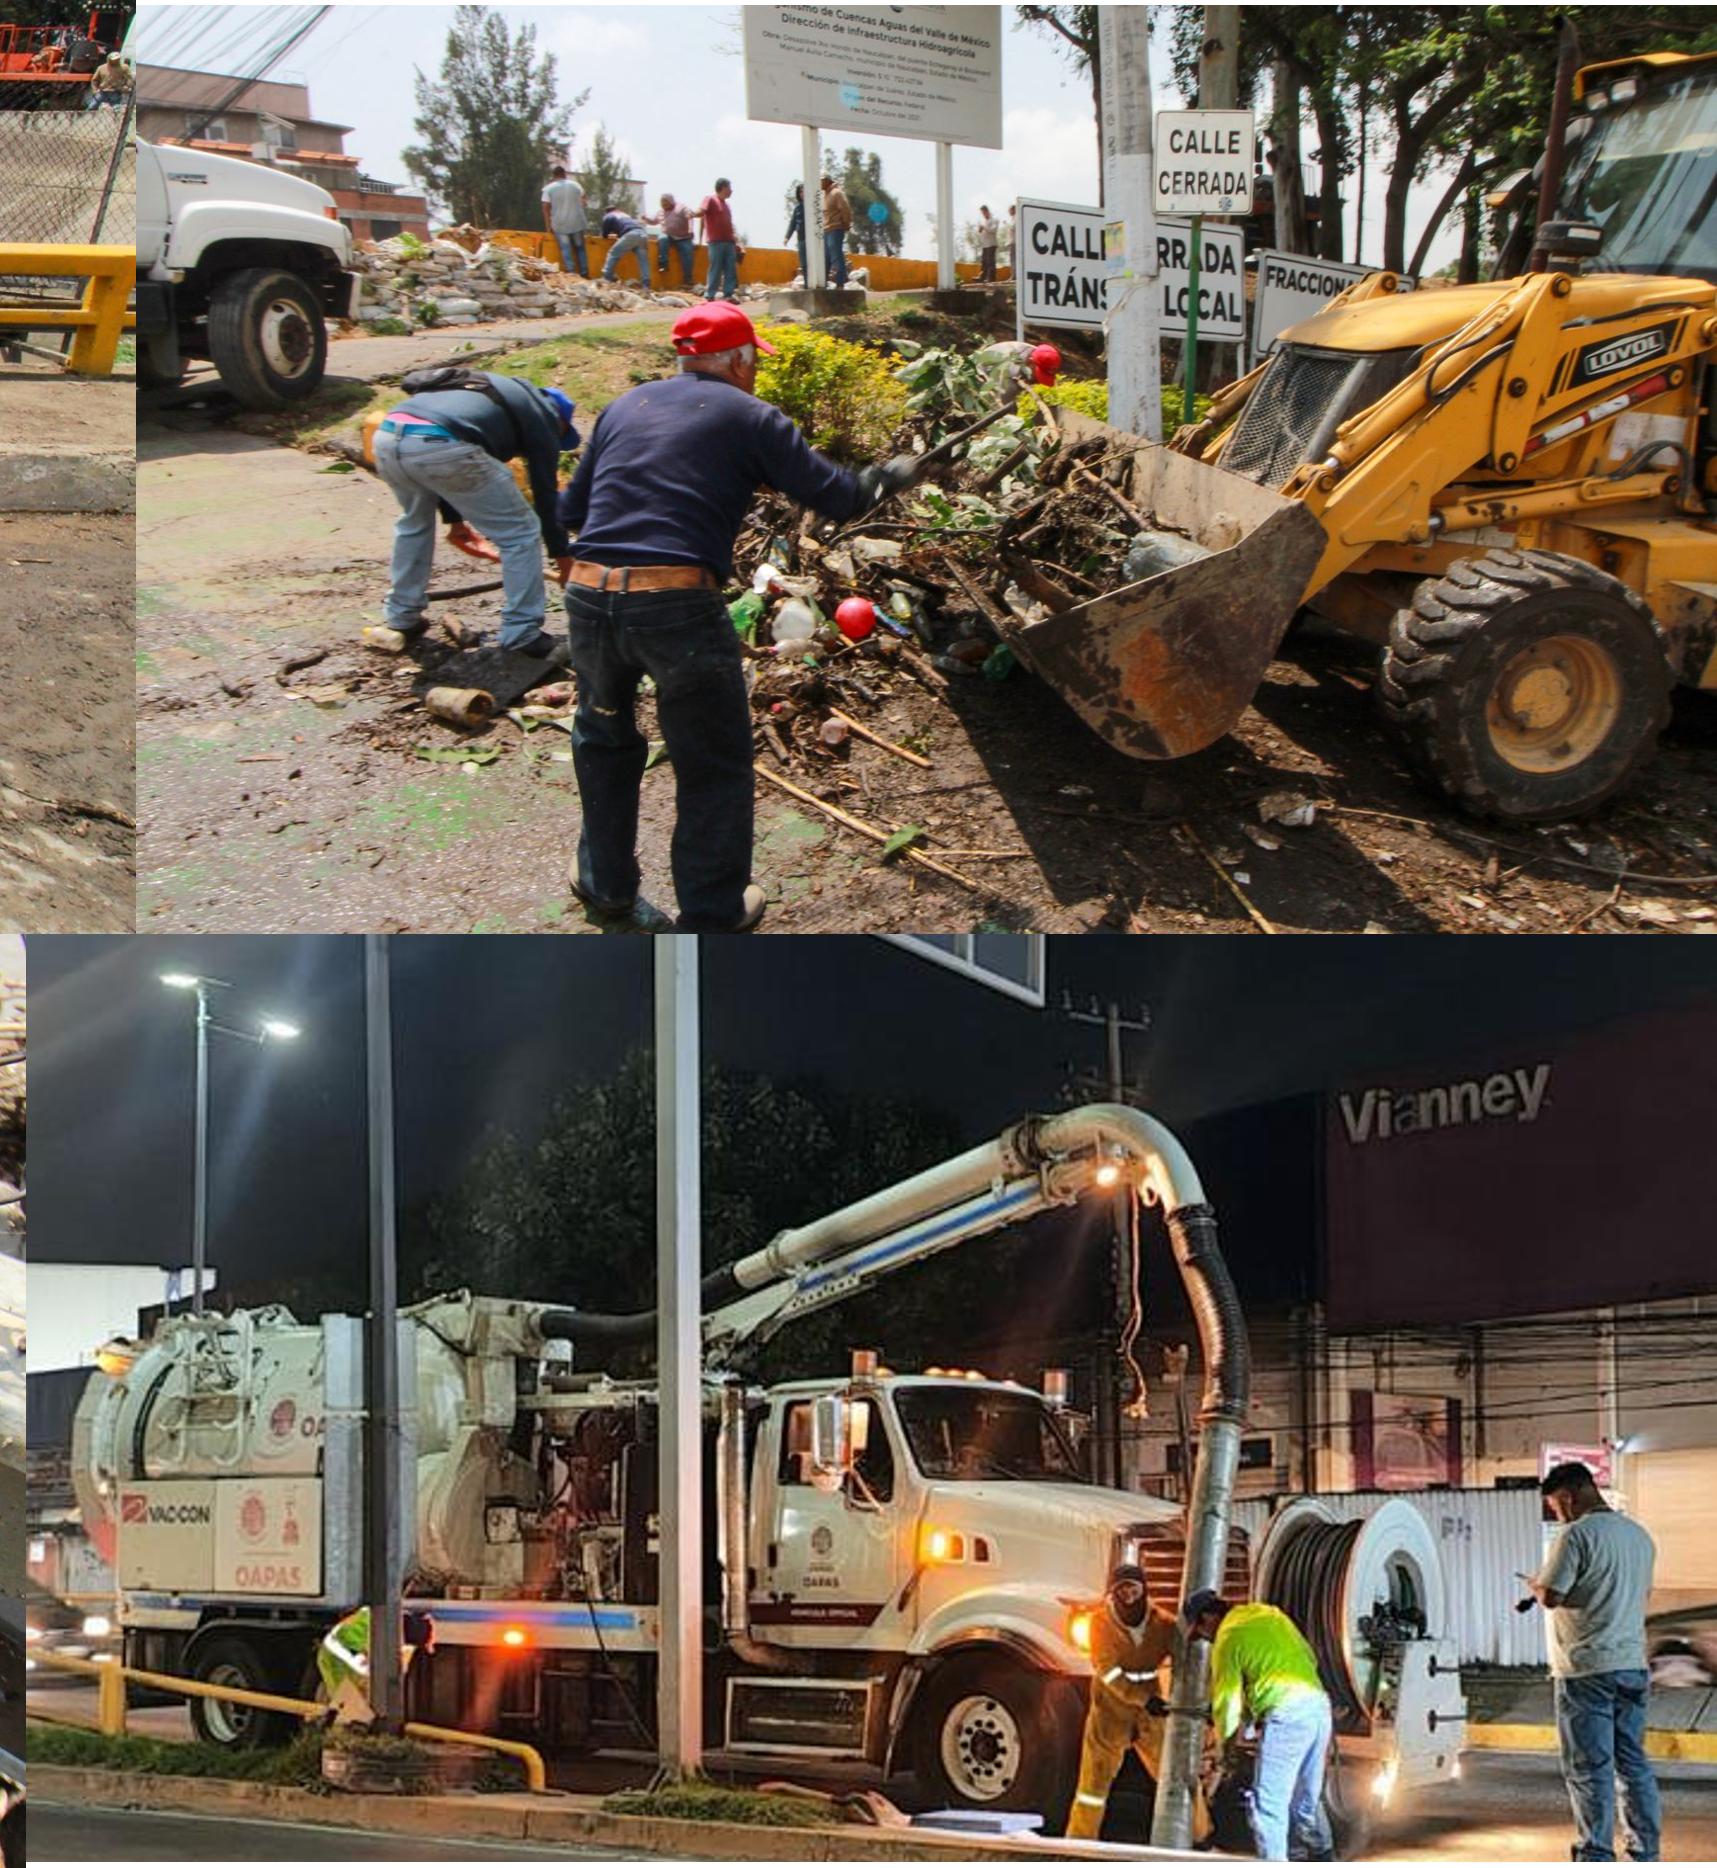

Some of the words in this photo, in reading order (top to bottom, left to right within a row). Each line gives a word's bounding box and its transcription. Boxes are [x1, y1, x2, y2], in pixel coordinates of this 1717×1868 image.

[781, 13, 830, 31] Dirección
[832, 23, 845, 34] de
[847, 26, 917, 48] Infraestructura
[821, 6, 833, 17] de
[836, 9, 877, 26] Cuencas
[879, 18, 908, 32] Aguas
[909, 24, 924, 35] del
[925, 27, 946, 40] Valle
[948, 32, 959, 42] de
[961, 34, 991, 49] México
[1170, 129, 1241, 154] CALLE
[1159, 171, 1248, 196] CERRADA
[1032, 221, 1106, 261] CALL
[1164, 285, 1241, 323] LOCAL
[1590, 335, 1660, 371] LOVOL
[1340, 1064, 1550, 1143] Vianney
[235, 1566, 301, 1587] OAPAS
